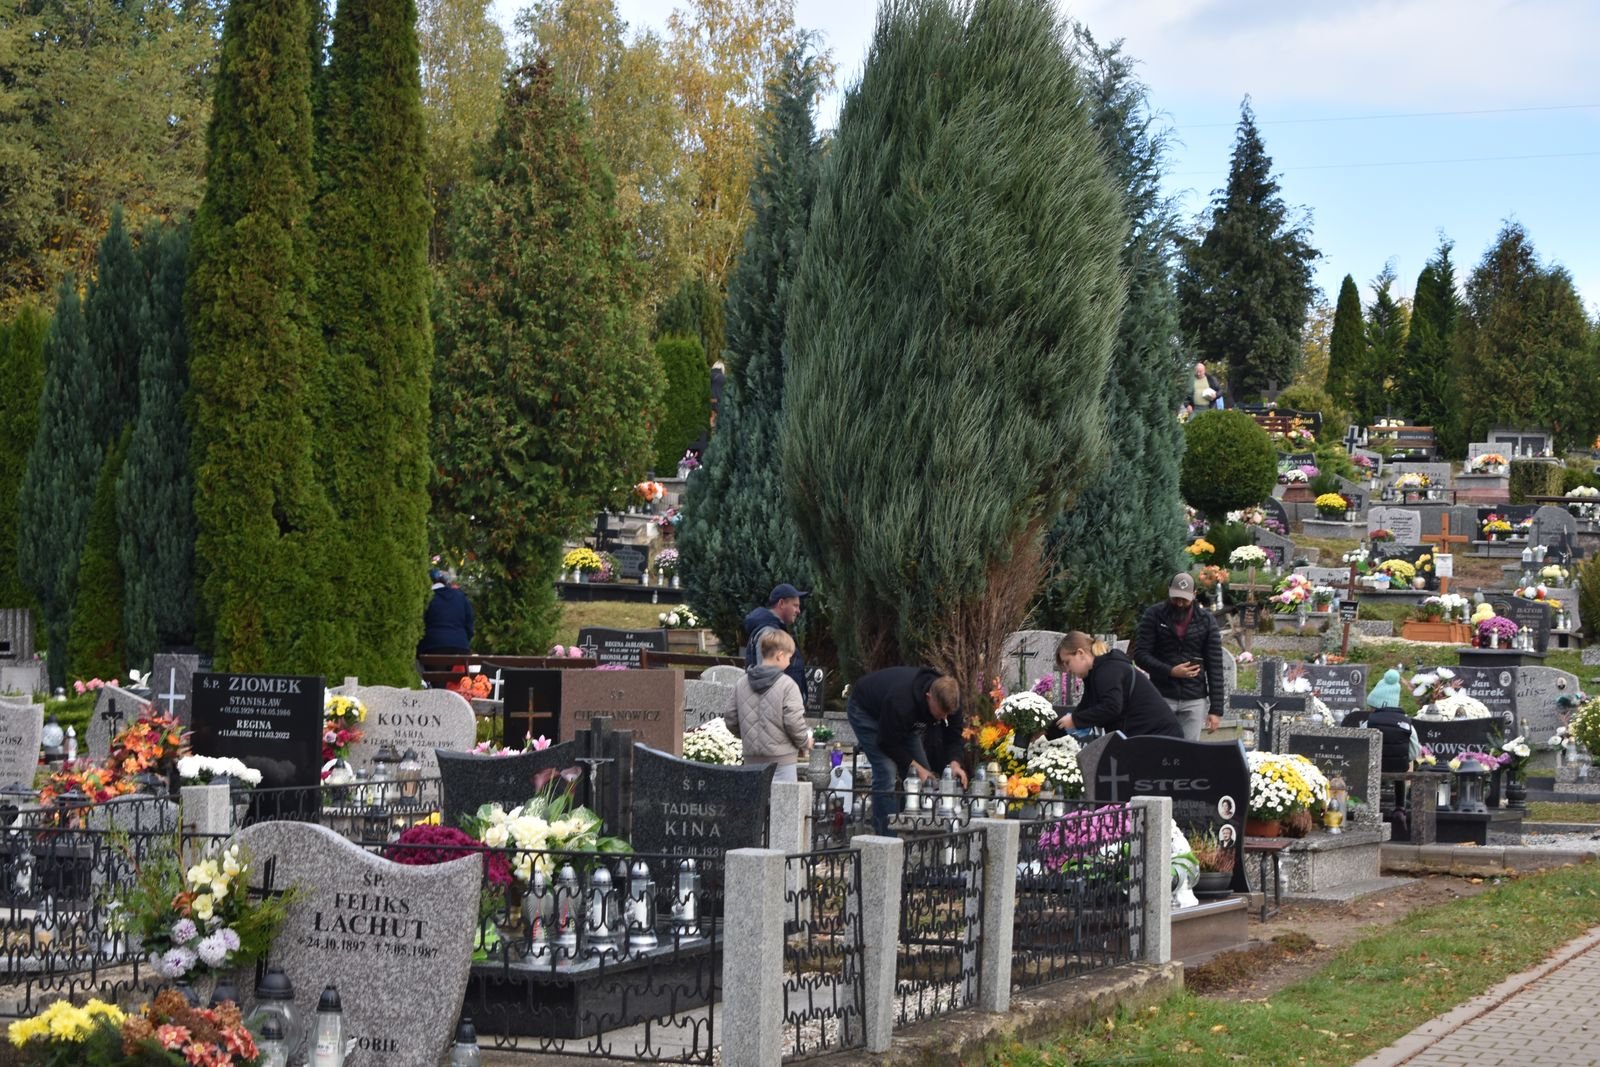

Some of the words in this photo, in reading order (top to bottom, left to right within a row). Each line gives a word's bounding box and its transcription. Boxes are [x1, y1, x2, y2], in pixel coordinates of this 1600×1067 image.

[228, 677, 302, 694] ZIOMEK
[1315, 678, 1350, 687] Eugenia
[1471, 679, 1490, 688] Jan
[1464, 687, 1505, 697] isarek
[230, 696, 282, 707] STANISŁAW
[236, 720, 272, 730] REGINA
[378, 713, 442, 727] KONON
[394, 730, 424, 739] MARIA
[1133, 778, 1211, 792] STEC
[662, 803, 727, 817] TADEUSZ
[665, 821, 721, 837] KINA
[334, 892, 410, 914] FELIKS
[306, 936, 366, 952] 24.10.1897
[385, 943, 438, 959] 7.05.1987
